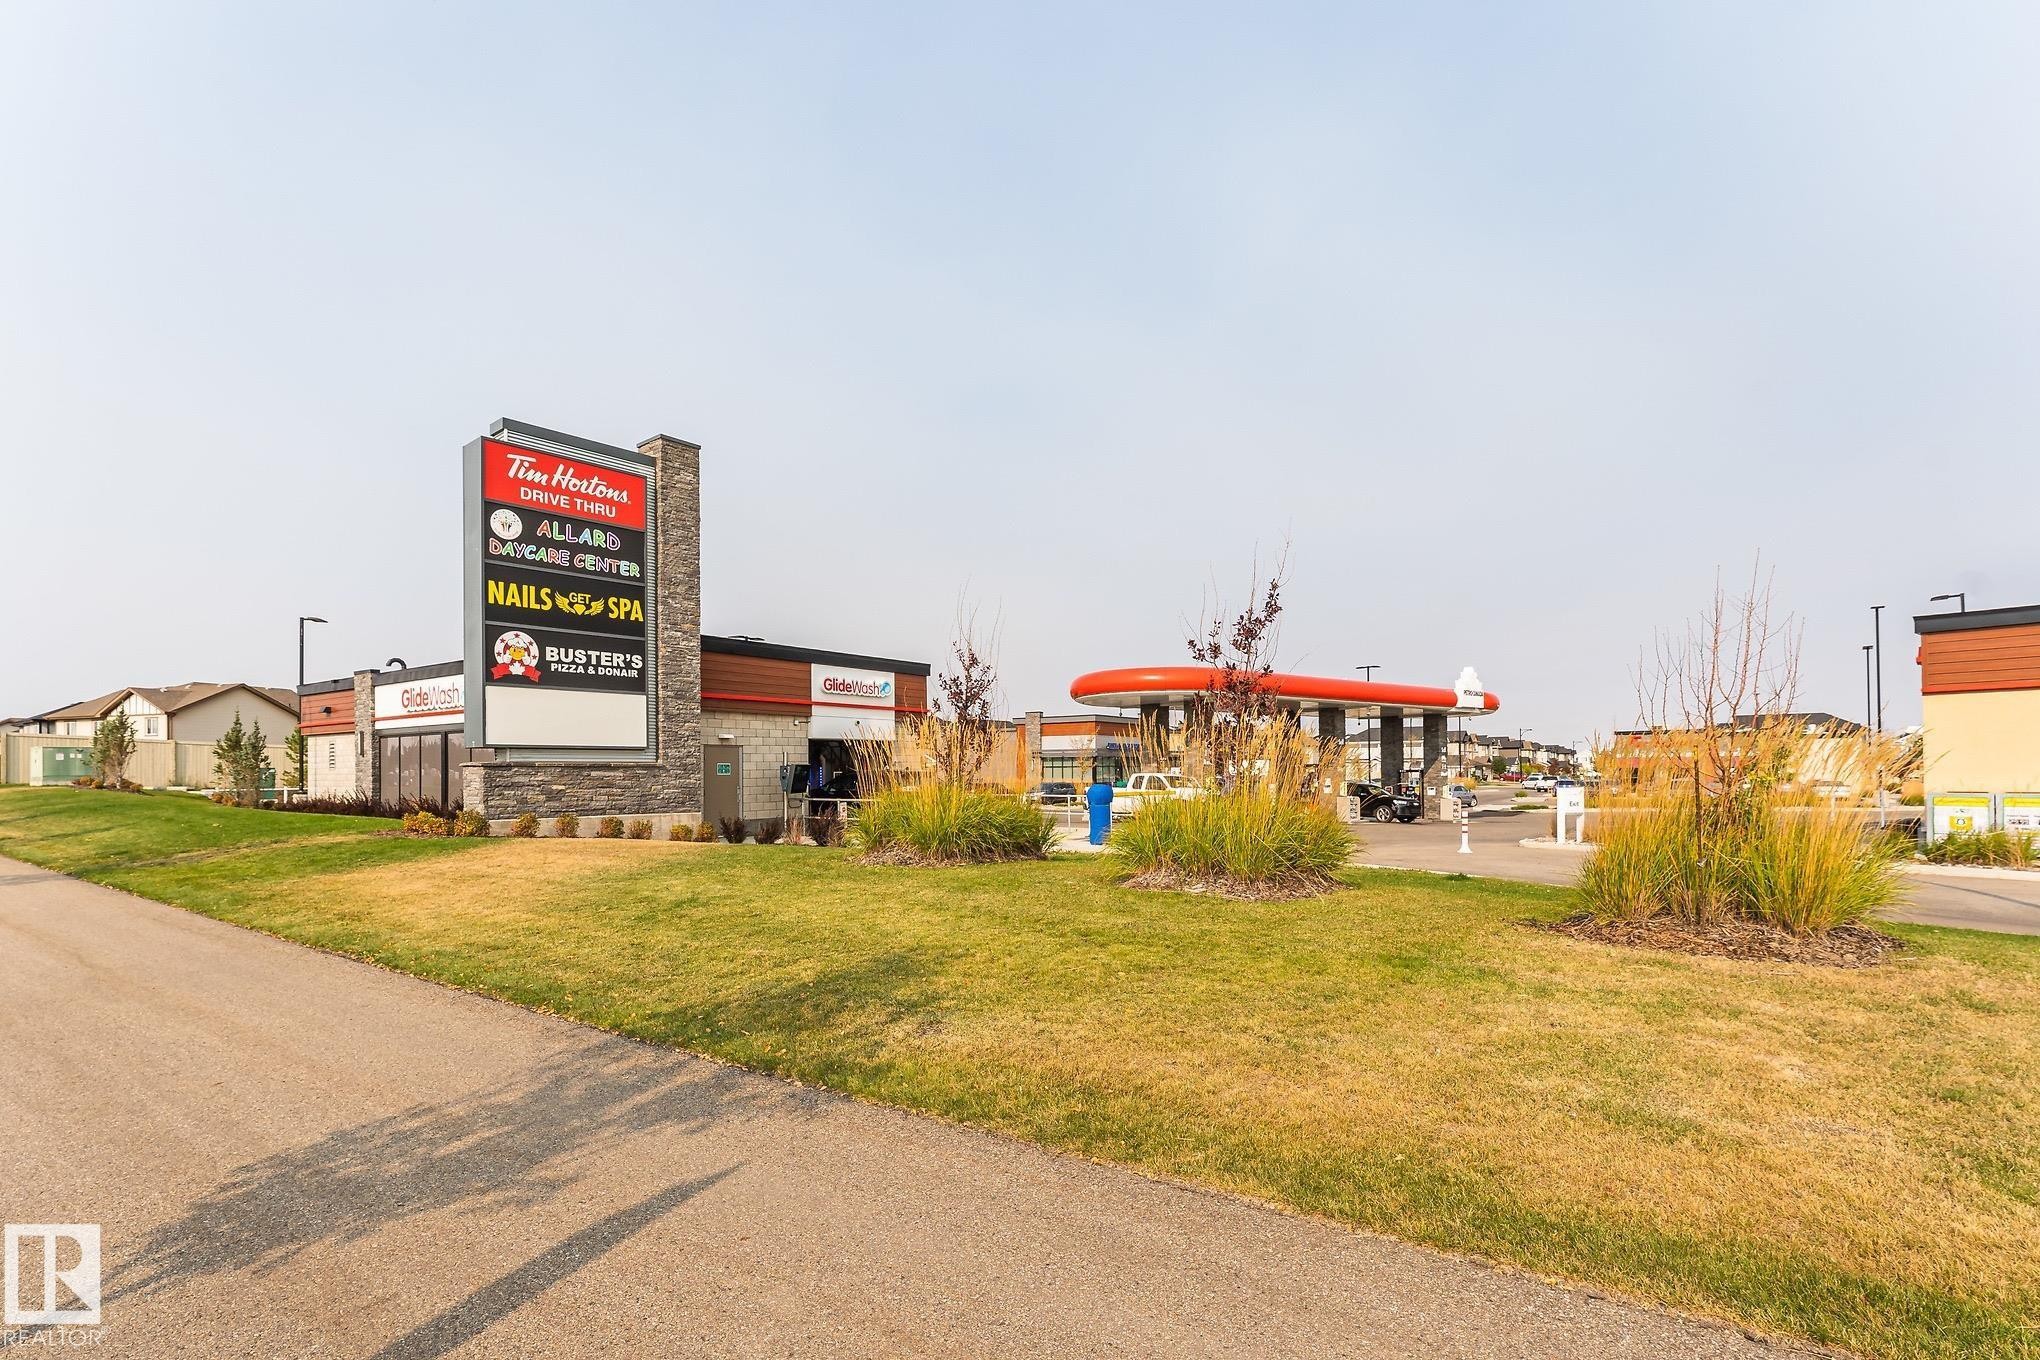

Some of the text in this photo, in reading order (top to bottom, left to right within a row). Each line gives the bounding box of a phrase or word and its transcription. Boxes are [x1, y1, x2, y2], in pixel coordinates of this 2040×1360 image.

[506, 453, 629, 504] Tim Hortons
[520, 486, 616, 518] DRIVE THRU
[536, 519, 621, 551] ALLARD
[488, 537, 641, 578] DAYCARE CENTER
[487, 579, 644, 622] NAILS GET SPA
[545, 646, 644, 669] BUSTER'S
[550, 662, 639, 678] PIZZA & DONAIR
[401, 681, 460, 709] GlideWash
[823, 677, 880, 696] GlideWash
